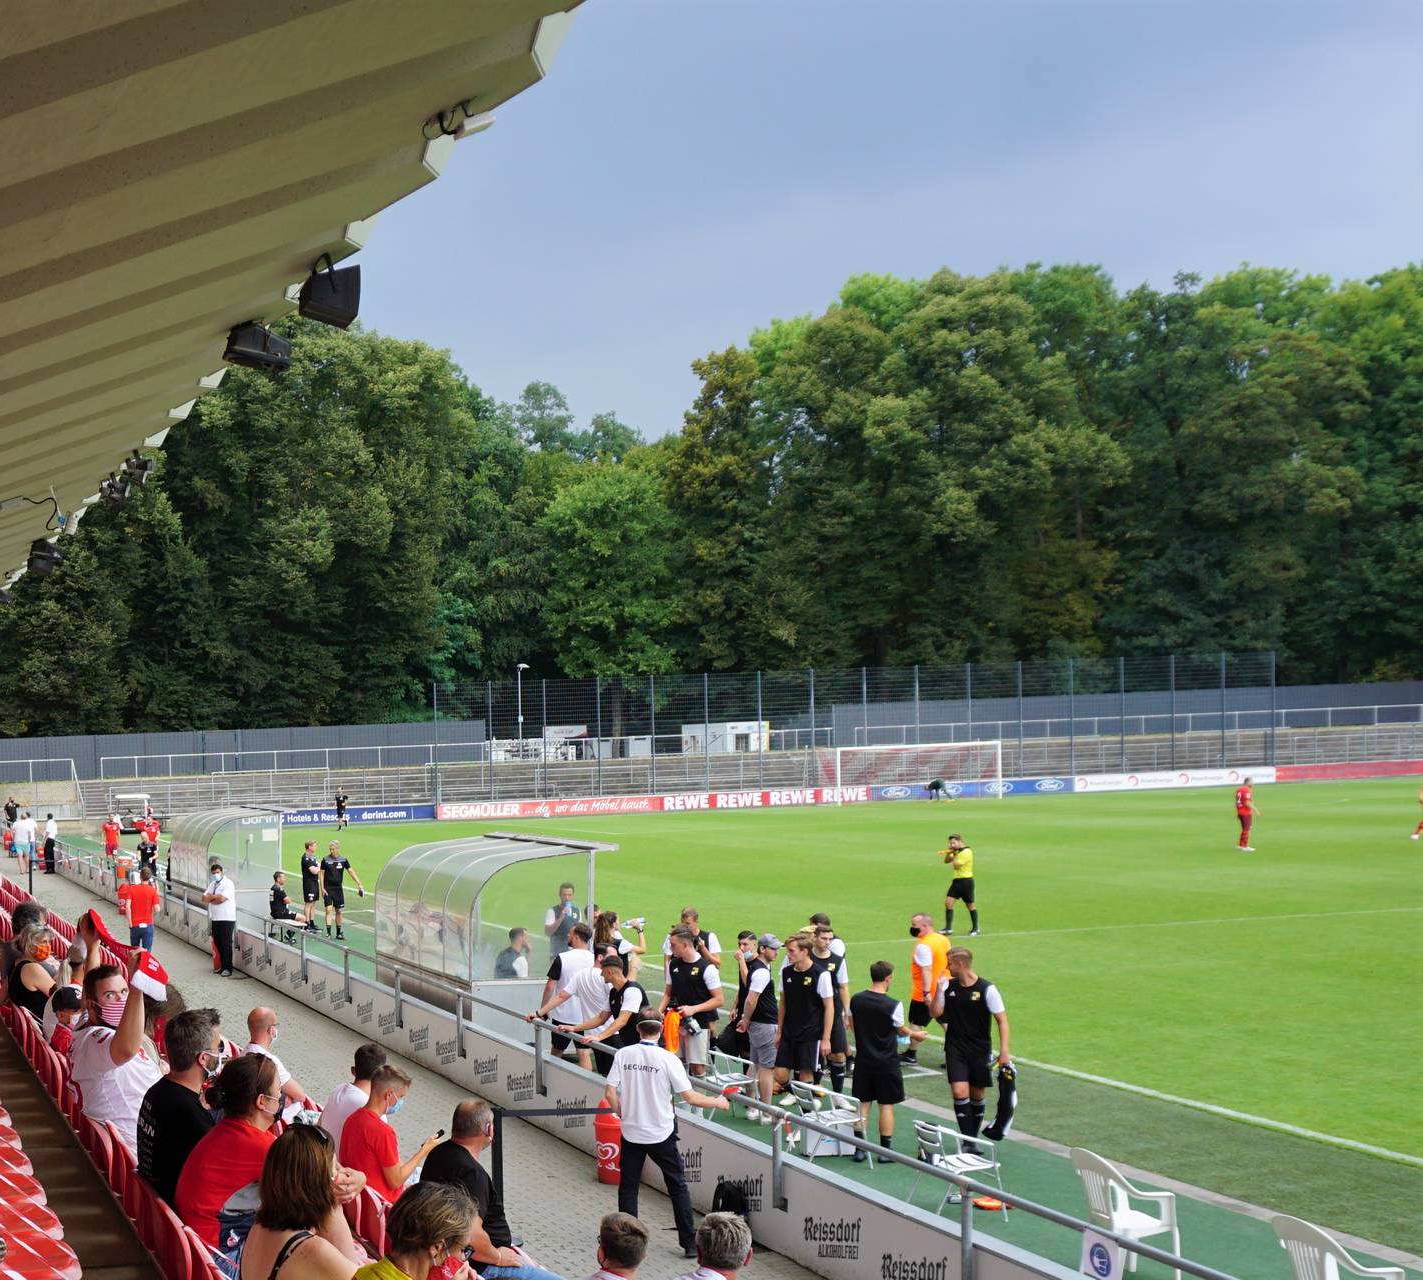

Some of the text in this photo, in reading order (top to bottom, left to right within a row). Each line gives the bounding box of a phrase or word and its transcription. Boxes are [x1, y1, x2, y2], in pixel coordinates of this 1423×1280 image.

[664, 795, 709, 810] REWE
[716, 792, 762, 808] REWE
[770, 789, 815, 805] REWE
[442, 803, 520, 818] SEGMÜLLER
[570, 801, 588, 813] das
[591, 798, 619, 811] Möbel
[287, 814, 312, 824] Hotels
[313, 814, 319, 822] &
[362, 810, 407, 820] dorint.com
[623, 1063, 660, 1074] SECURITY
[507, 1070, 535, 1092] Reissdorf
[804, 1217, 862, 1244] Reissdorf
[817, 1244, 859, 1260] ALKOHOLFREI
[881, 1253, 948, 1280] Reissdorf
